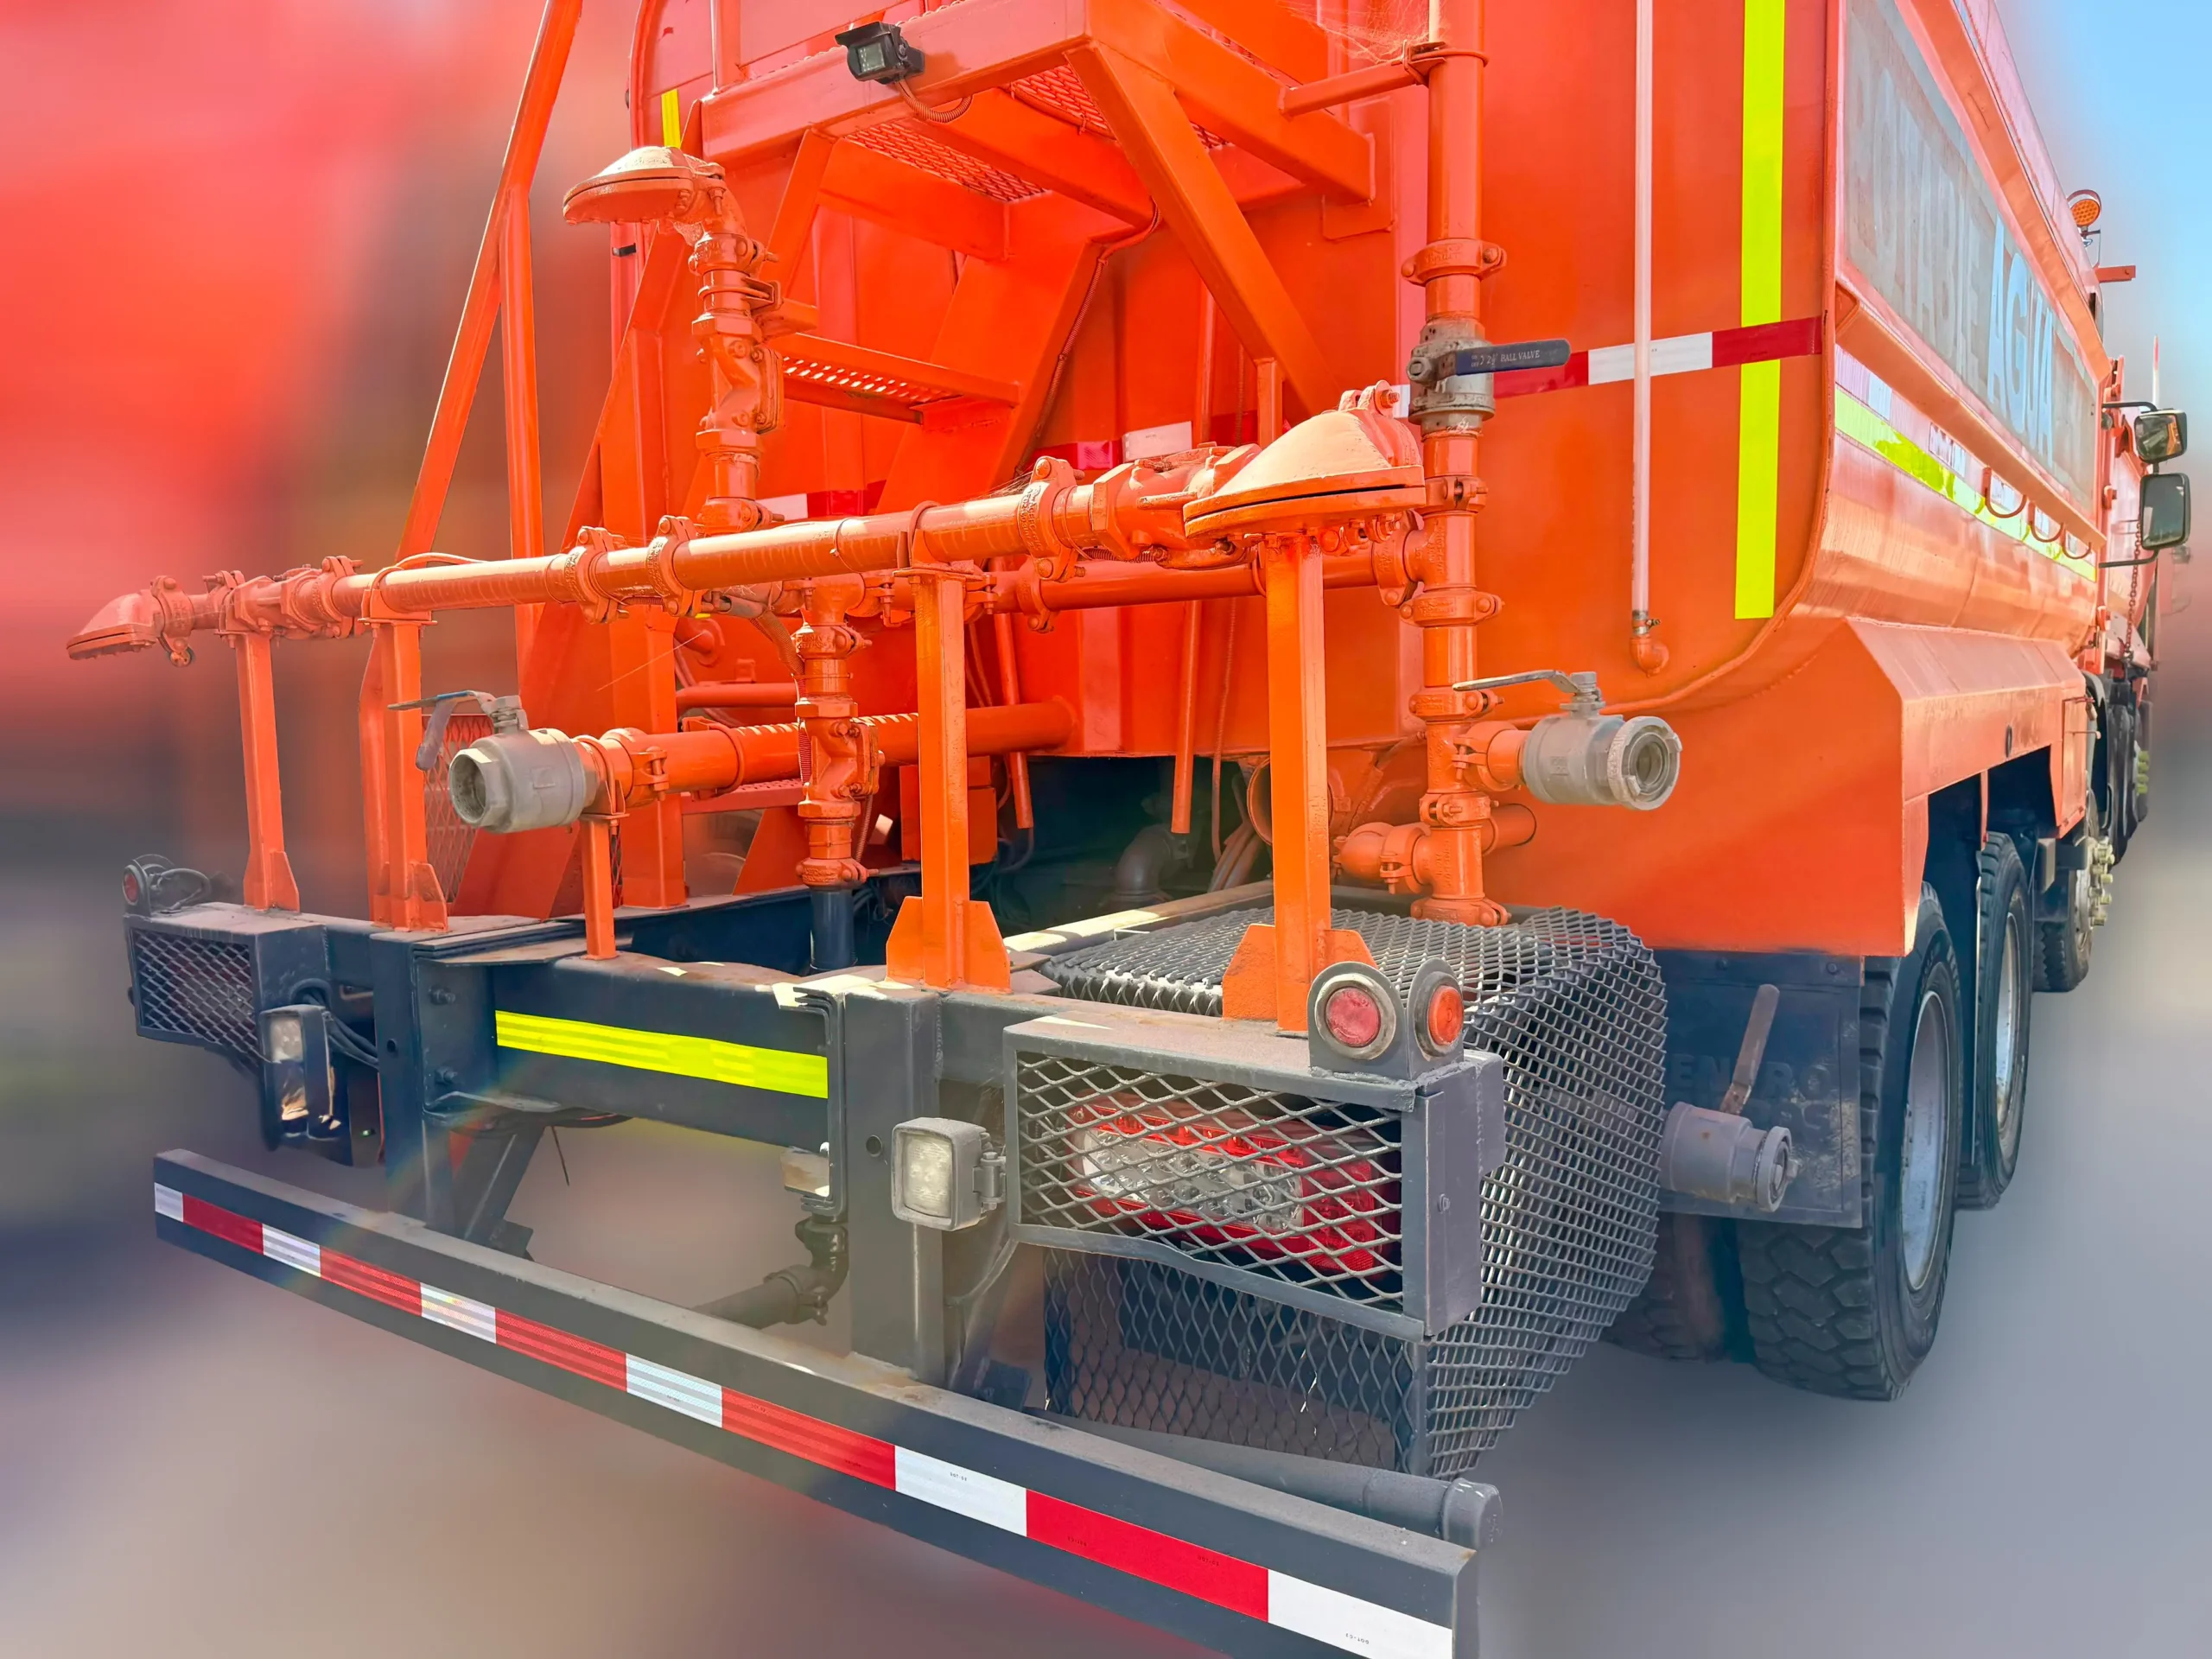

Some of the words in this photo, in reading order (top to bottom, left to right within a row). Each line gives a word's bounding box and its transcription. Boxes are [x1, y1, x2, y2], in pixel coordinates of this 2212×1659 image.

[1500, 353, 1517, 363] BALL
[1518, 349, 1541, 359] VALVE
[1989, 214, 2054, 469] AGUA
